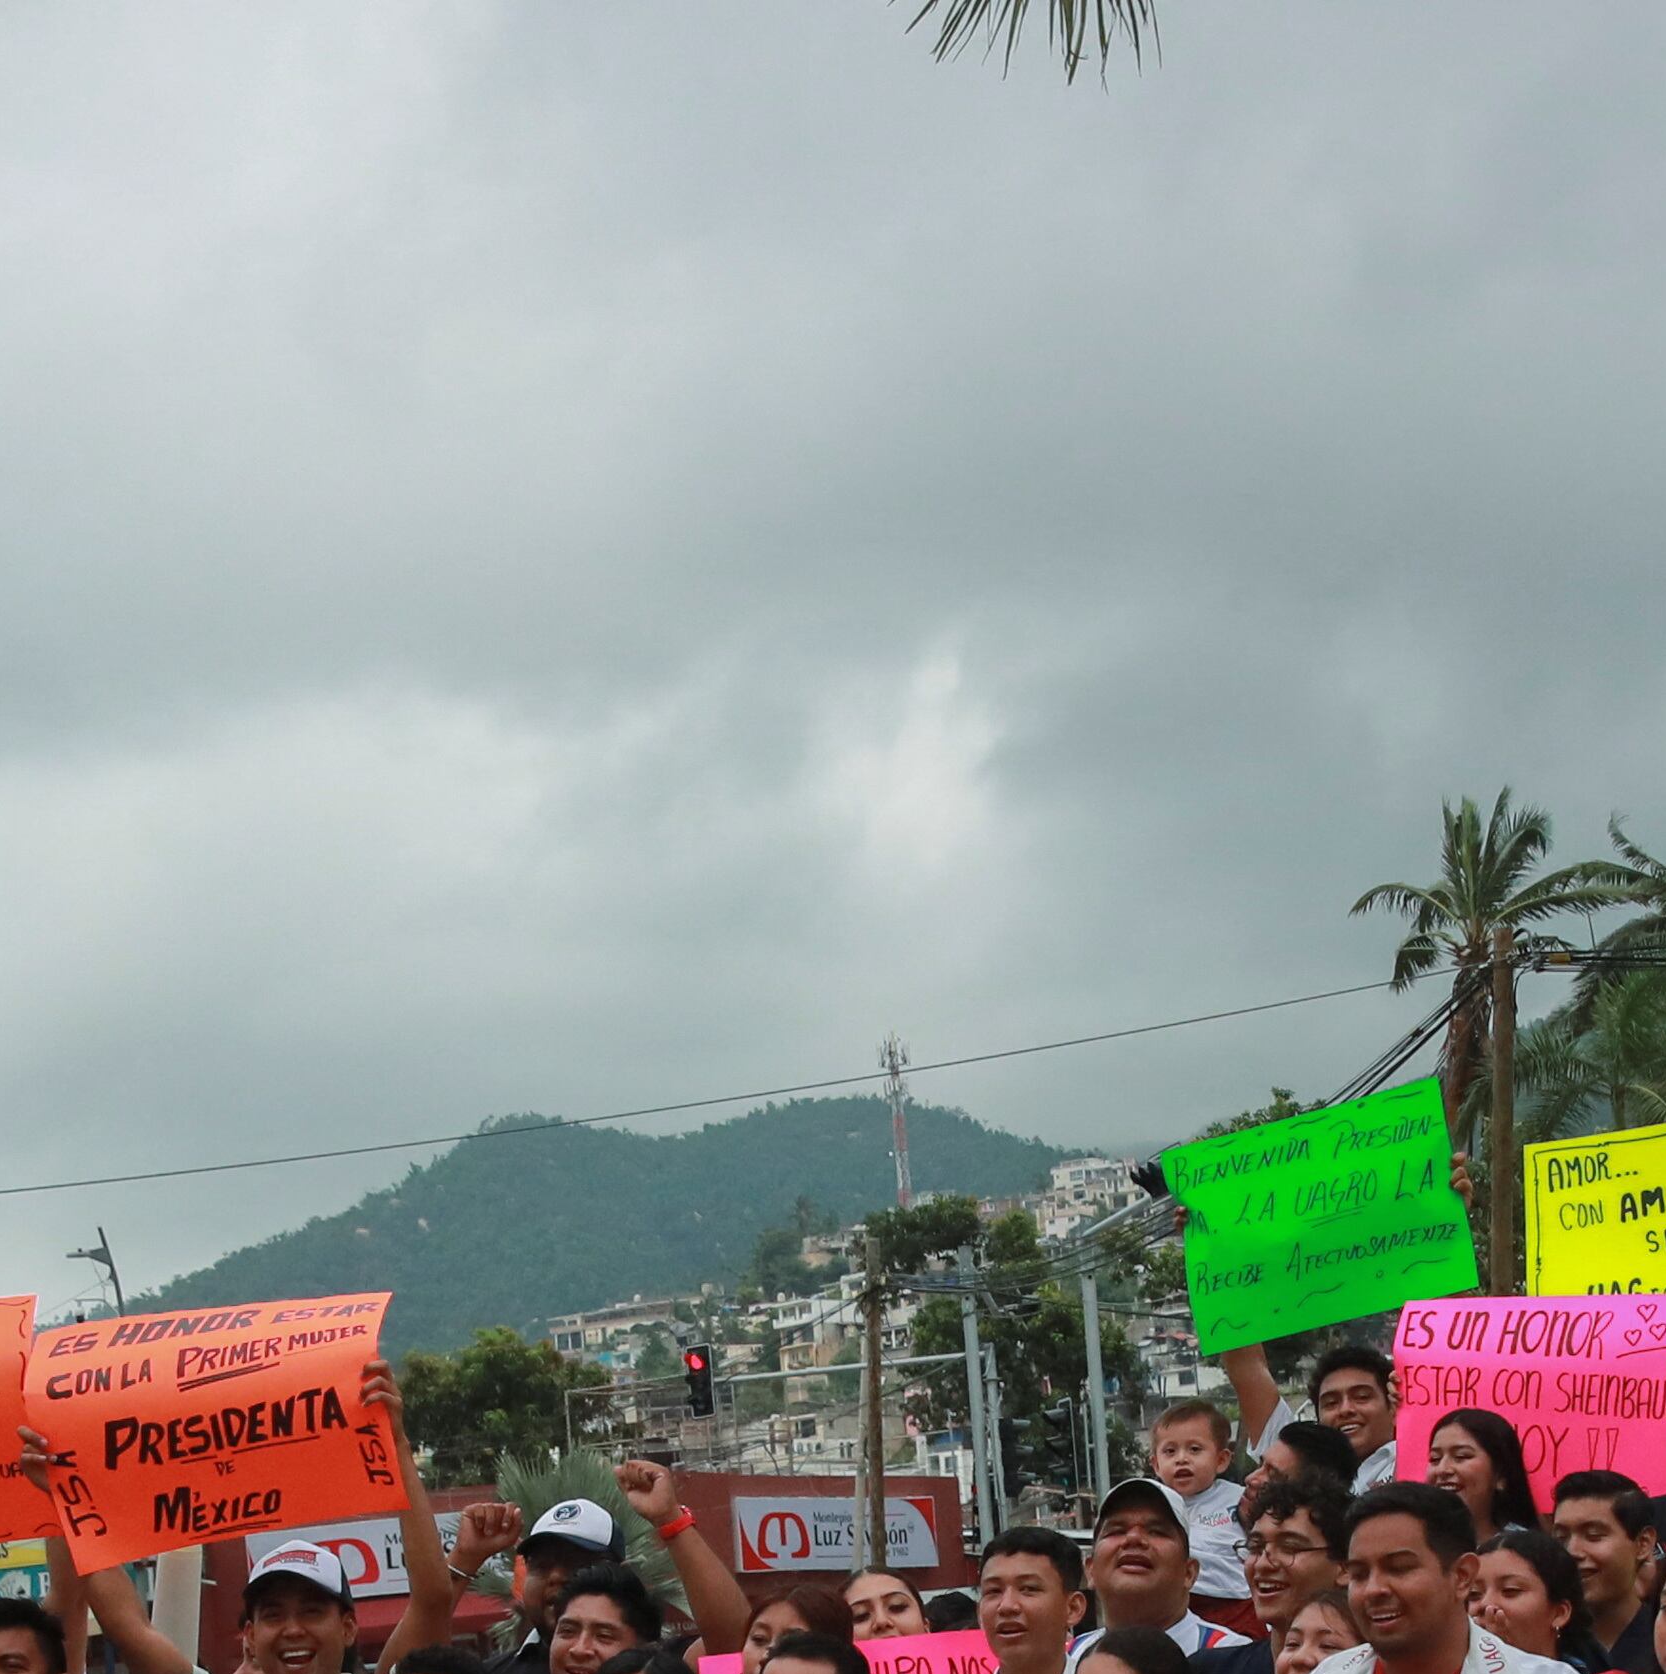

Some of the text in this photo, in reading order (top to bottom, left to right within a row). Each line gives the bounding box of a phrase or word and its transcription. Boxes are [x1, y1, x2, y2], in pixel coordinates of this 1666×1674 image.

[1174, 1138, 1310, 1194] BIENVENIDA
[1235, 1193, 1274, 1225] LA
[1396, 1159, 1433, 1200] LA
[1560, 1203, 1604, 1231] CON
[1196, 1263, 1265, 1295] RECIBE
[48, 1302, 379, 1358] ES HONOR ESTAR
[1403, 1310, 1613, 1360] ES UN HONOR
[46, 1369, 111, 1400] CON
[120, 1359, 152, 1390] LA
[287, 1324, 367, 1351] MUJER
[1404, 1366, 1542, 1409] ESTAR CON
[104, 1386, 348, 1470] PRESIDENTA
[215, 1461, 235, 1477] DE
[814, 1525, 842, 1546] Luz
